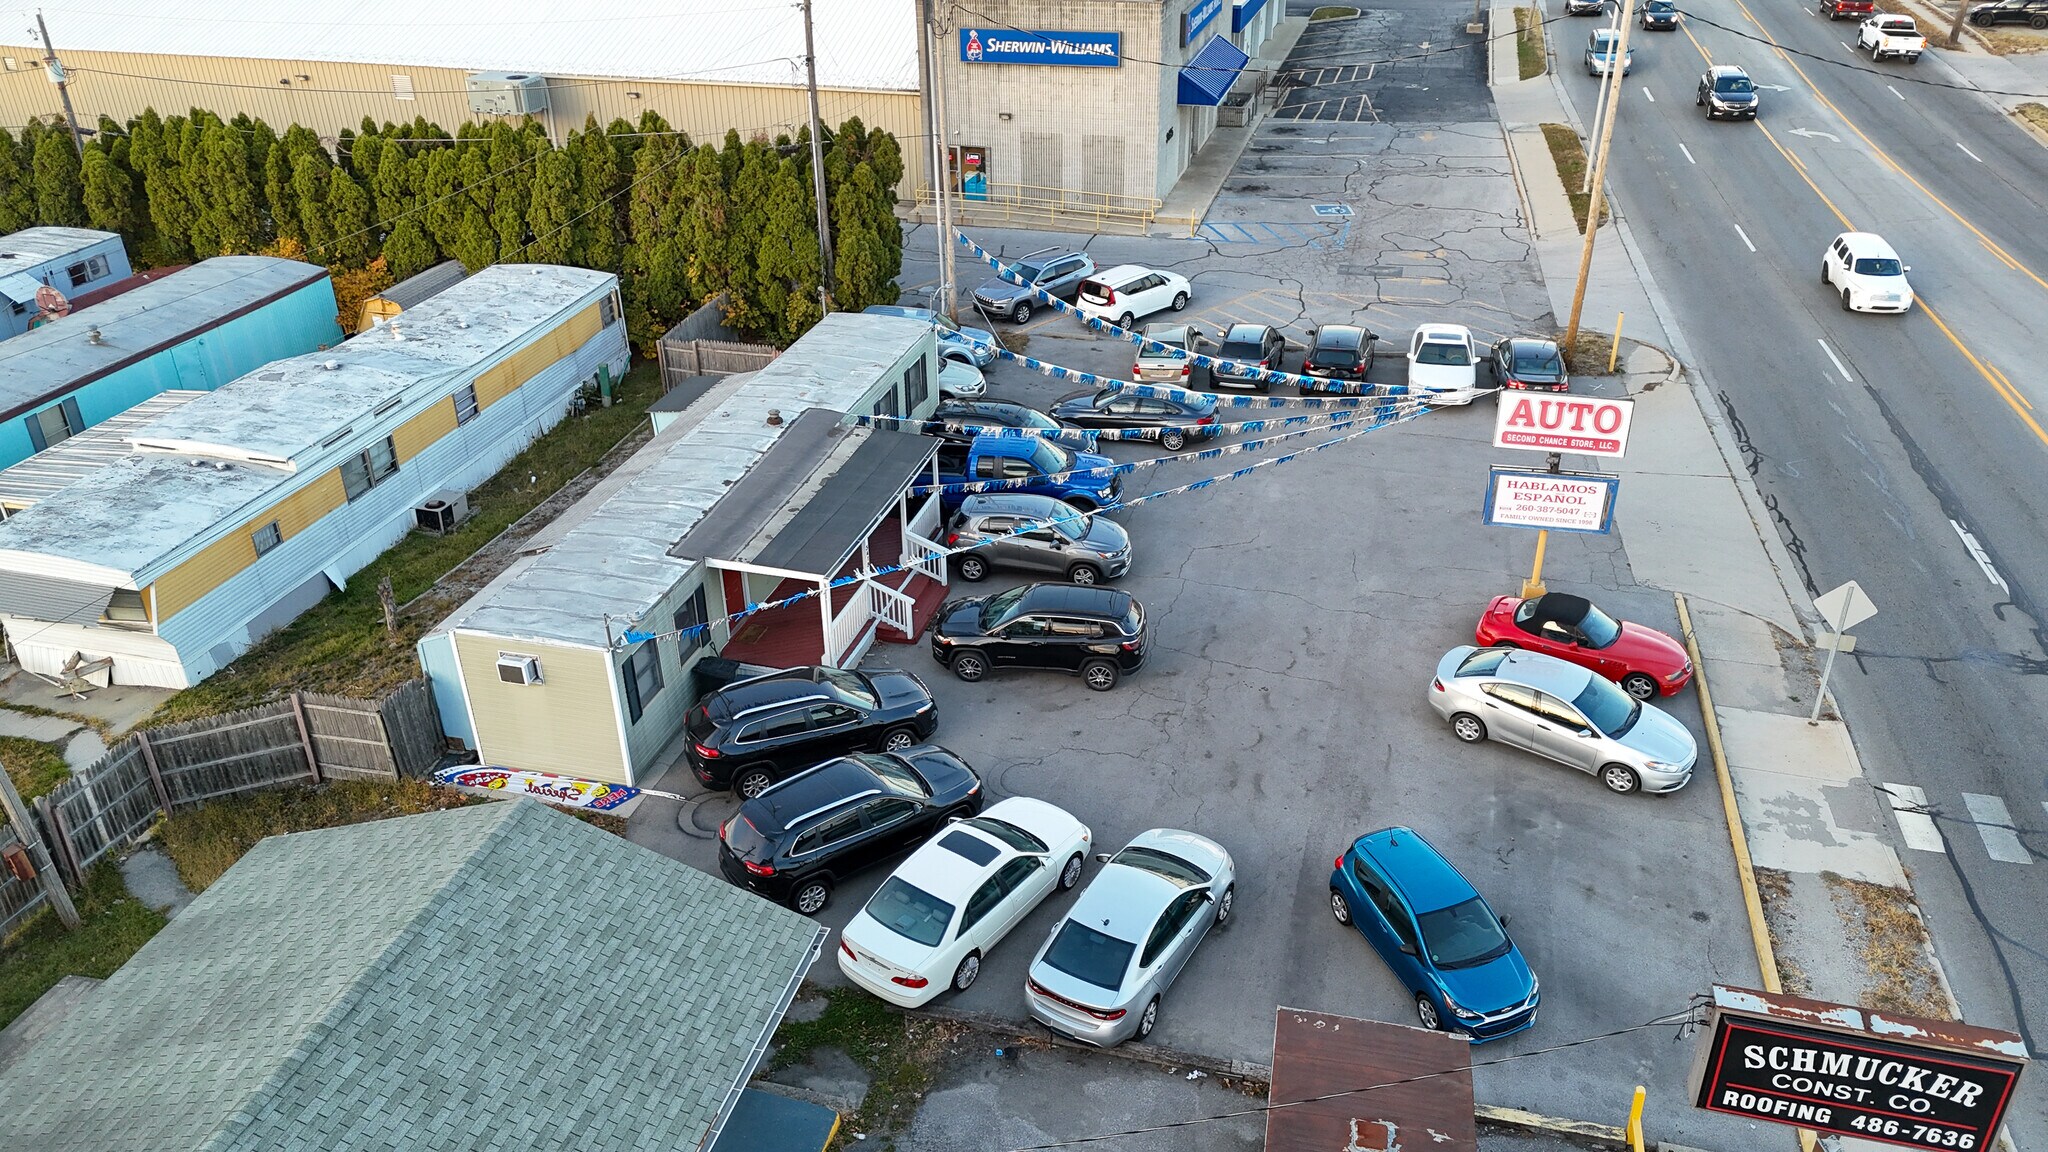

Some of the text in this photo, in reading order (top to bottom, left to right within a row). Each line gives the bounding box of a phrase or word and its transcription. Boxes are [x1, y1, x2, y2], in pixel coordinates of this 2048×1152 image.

[1506, 398, 1623, 434] AUTO
[1506, 434, 1615, 450] SECOND CHANCE STORE, LLC.
[1507, 480, 1598, 494] HABLAMOS
[1513, 492, 1586, 505] ESPAÑOL
[1515, 504, 1580, 515] 260-387-5047
[1743, 1044, 1984, 1109] SCHMUCKER
[1771, 1073, 1936, 1115] CONST. CO.
[1722, 1090, 1976, 1150] ROOFING 486-7636
